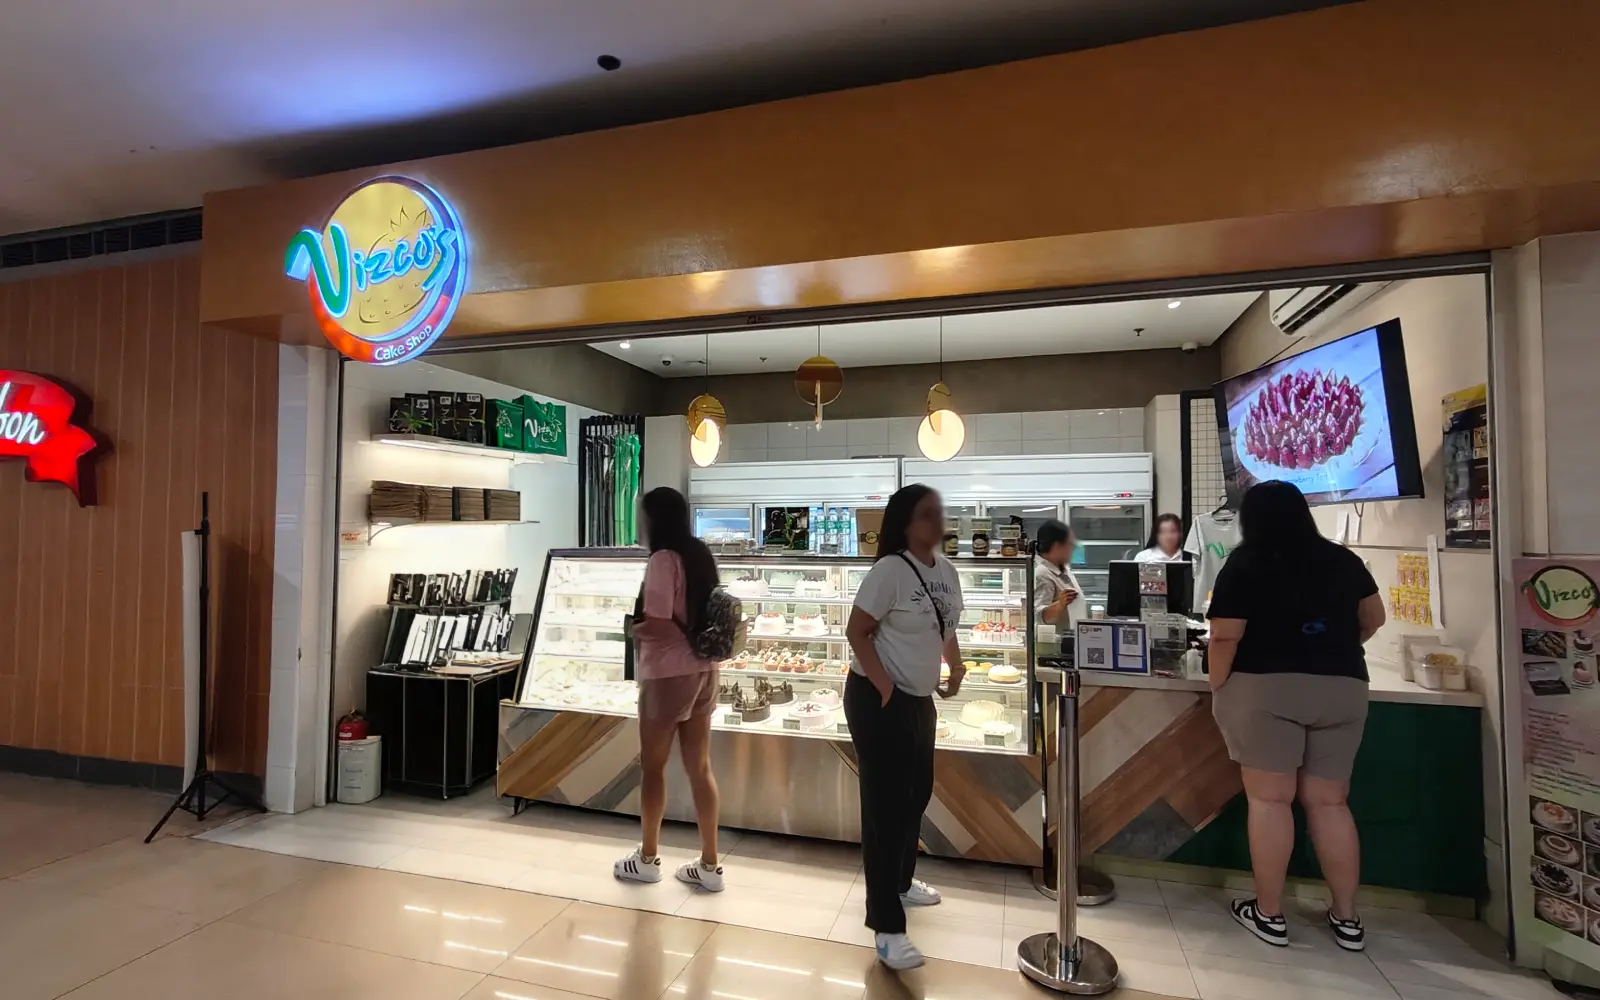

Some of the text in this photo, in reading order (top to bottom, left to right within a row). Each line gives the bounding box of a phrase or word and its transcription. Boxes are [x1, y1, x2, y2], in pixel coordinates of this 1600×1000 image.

[284, 222, 457, 318] Vizco's
[374, 325, 433, 361] Cake Shop
